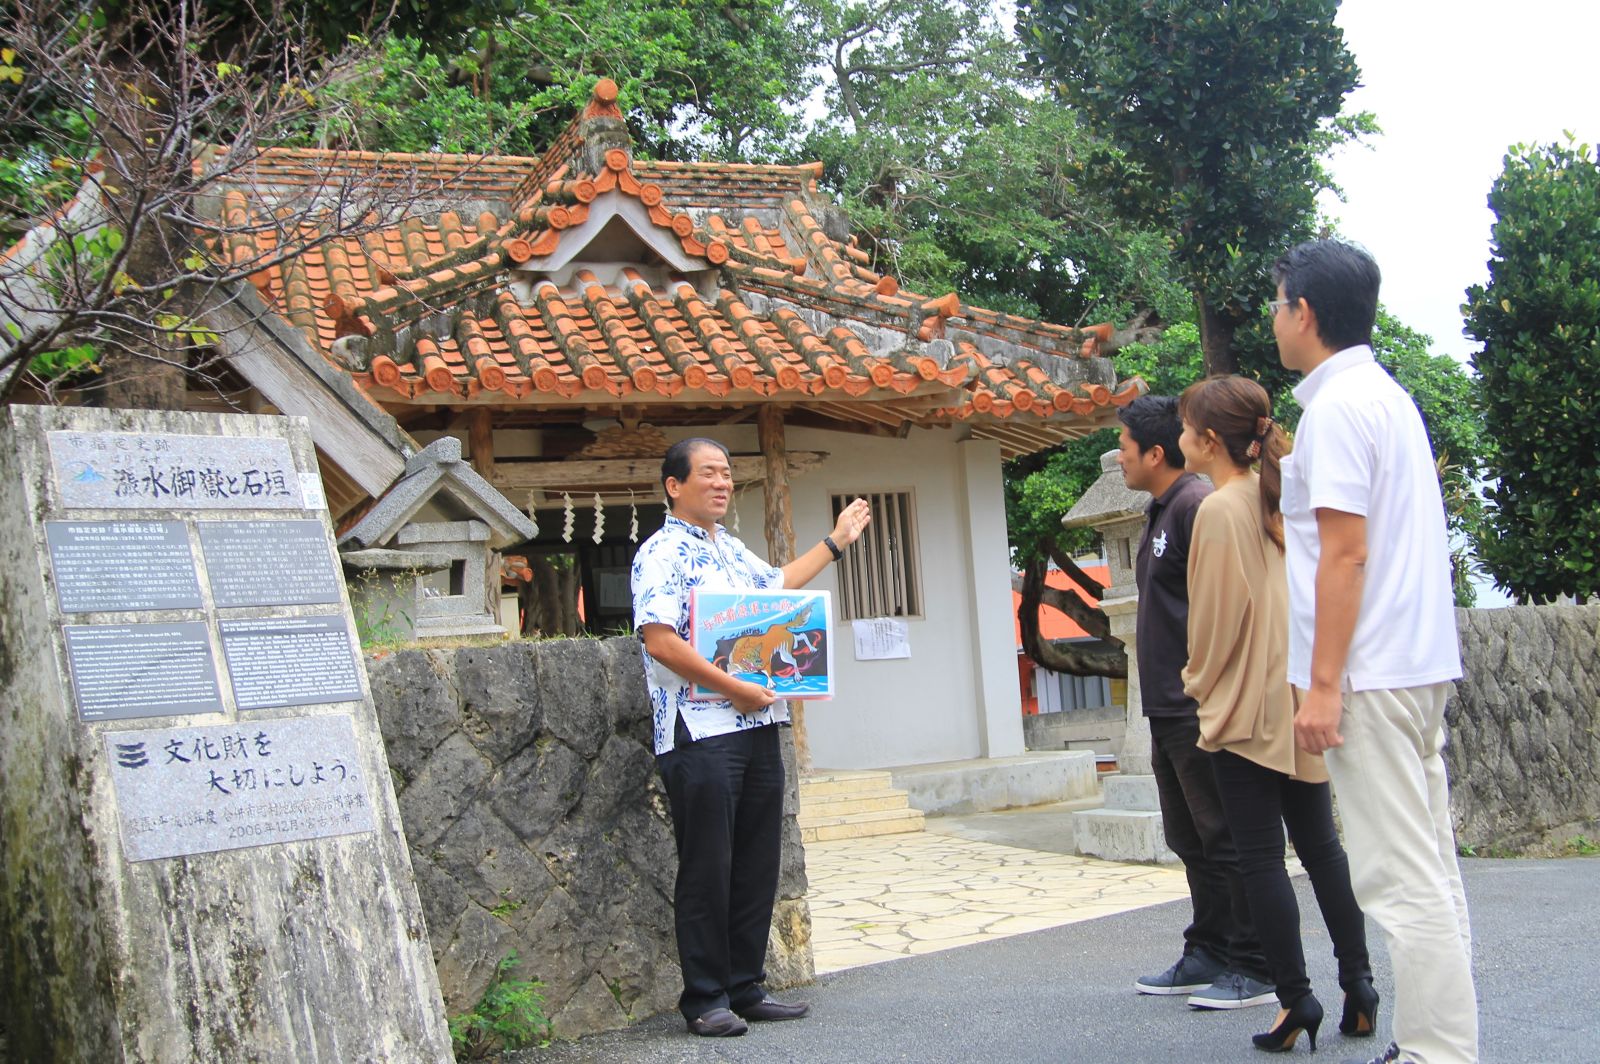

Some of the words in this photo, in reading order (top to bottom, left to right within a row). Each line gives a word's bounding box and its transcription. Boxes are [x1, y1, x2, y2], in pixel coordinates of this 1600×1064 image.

[163, 731, 273, 765] 文化財を
[206, 760, 358, 794] 大切にしよう。
